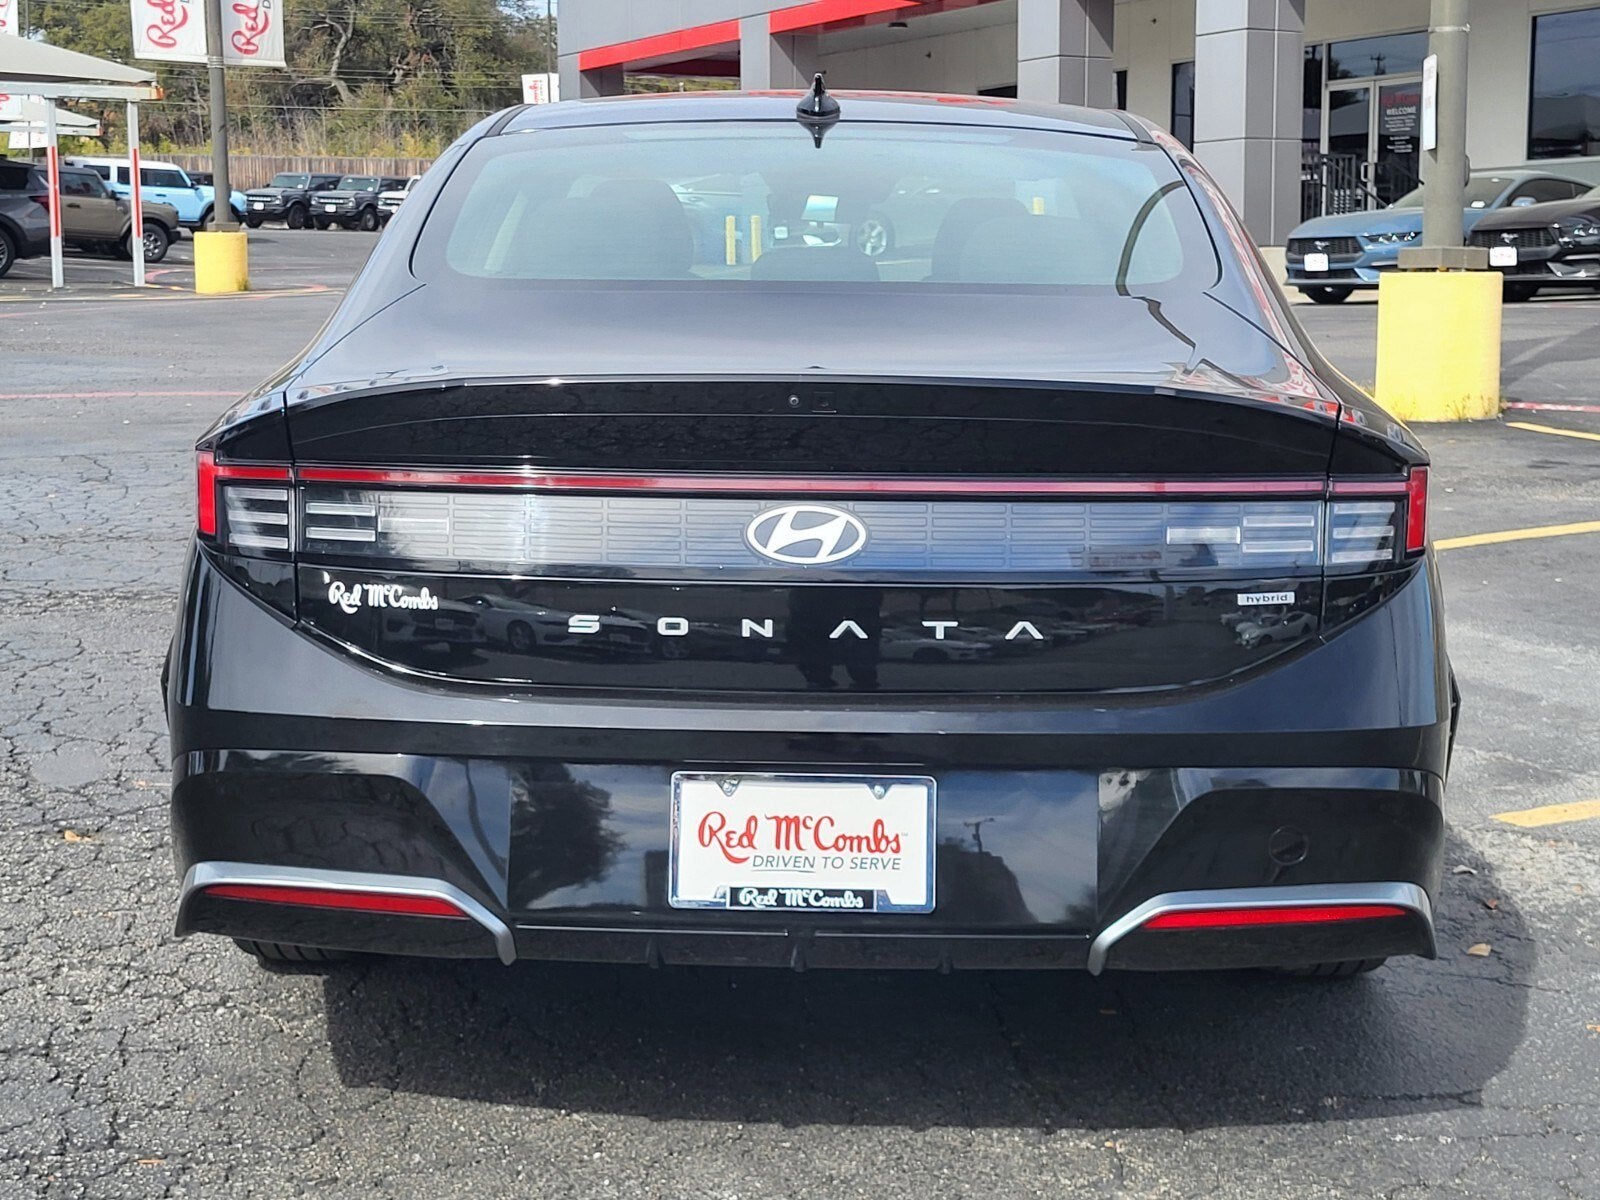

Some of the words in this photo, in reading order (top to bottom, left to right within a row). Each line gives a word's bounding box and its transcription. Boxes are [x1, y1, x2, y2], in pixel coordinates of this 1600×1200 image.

[146, 0, 189, 49] Red
[231, 1, 270, 55] Red
[1386, 105, 1417, 116] WELCOME
[328, 581, 362, 614] Red
[363, 583, 438, 610] McCombs
[1246, 593, 1288, 603] hybrid
[567, 614, 1044, 640] SONATA
[698, 811, 758, 864] Red
[765, 813, 901, 854] McCombs
[752, 855, 816, 869] DRIVEN
[822, 856, 844, 869] TO
[849, 856, 902, 871] SERVE
[738, 887, 778, 909] Red
[779, 889, 864, 908] McCombs
